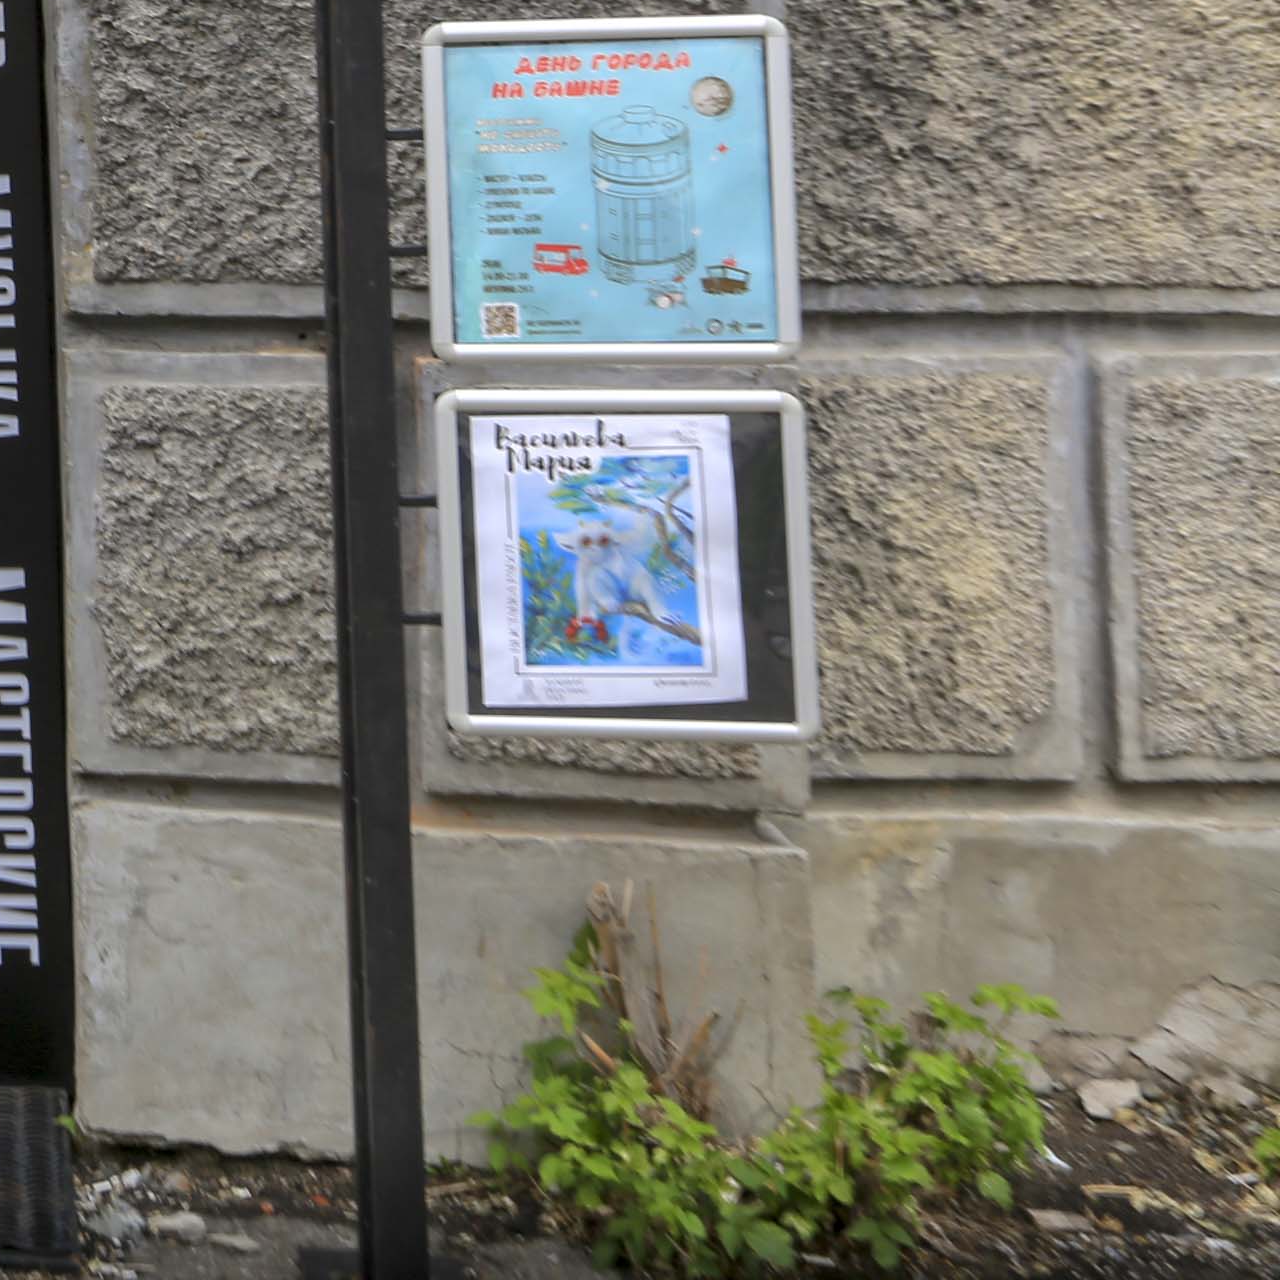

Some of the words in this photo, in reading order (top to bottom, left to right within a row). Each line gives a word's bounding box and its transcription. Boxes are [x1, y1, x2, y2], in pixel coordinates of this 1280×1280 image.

[514, 56, 582, 75] ДЕНЬ
[592, 51, 691, 71] ГОРОДА
[492, 81, 524, 99] НА
[533, 79, 621, 97] БАШНЕ
[505, 446, 592, 481] Мария
